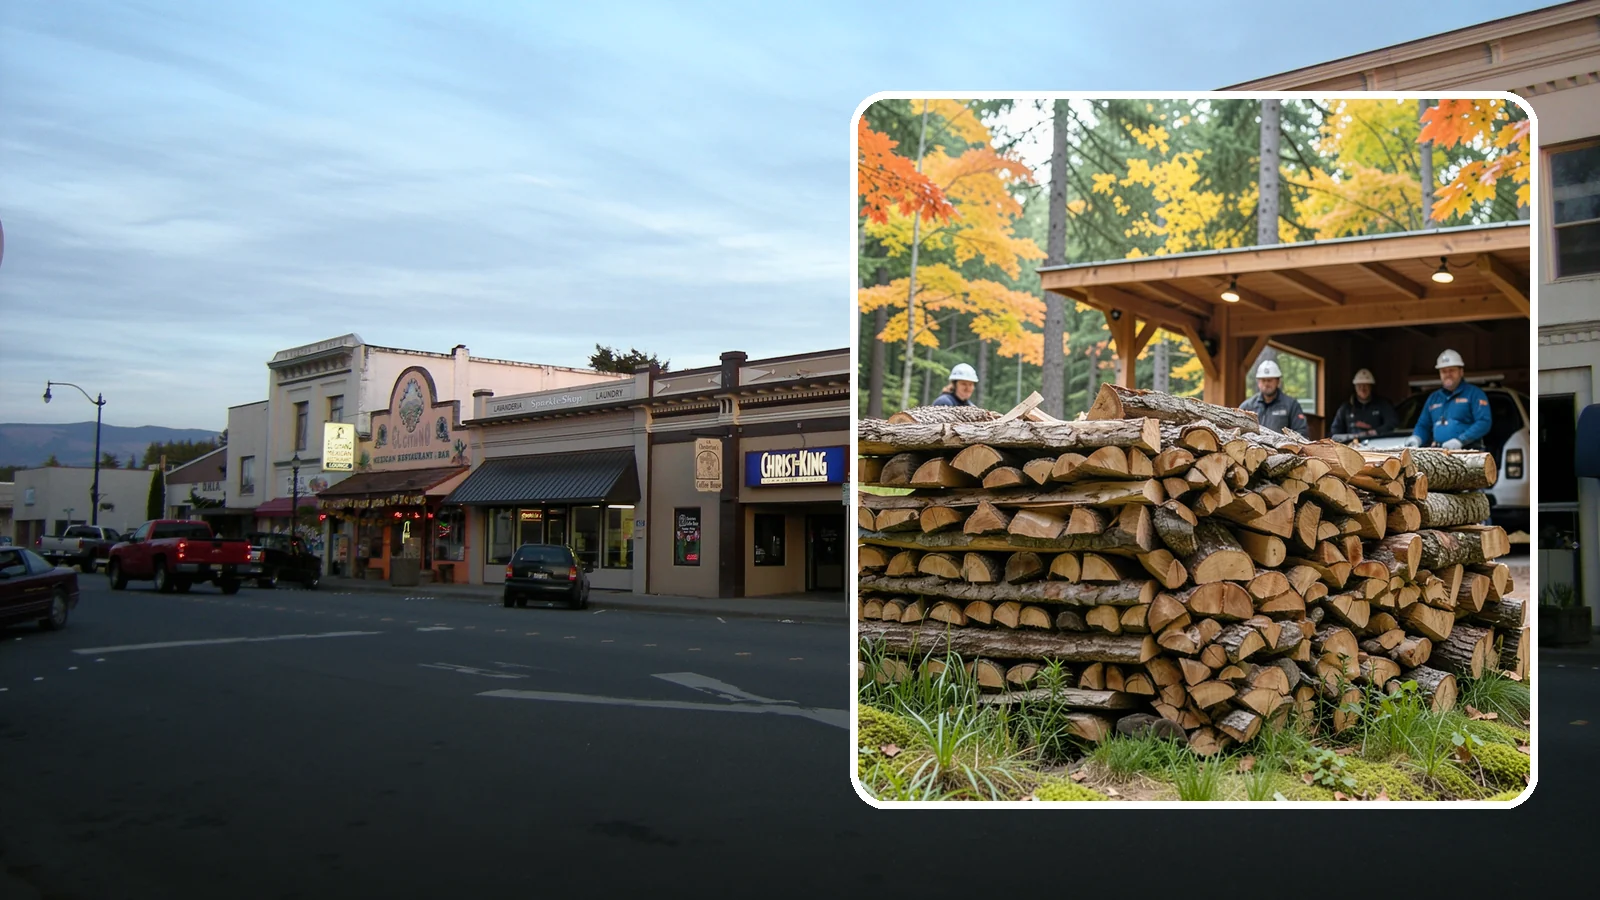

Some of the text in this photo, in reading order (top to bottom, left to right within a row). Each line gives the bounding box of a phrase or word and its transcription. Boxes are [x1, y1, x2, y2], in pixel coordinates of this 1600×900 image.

[493, 389, 624, 413] LAVANDERIA Sparkle Shop LAUNDRY
[374, 454, 396, 464] MEXICAN
[397, 451, 433, 462] RESTAURANT
[438, 450, 450, 459] BAR
[761, 450, 827, 478] CHRIST KING
